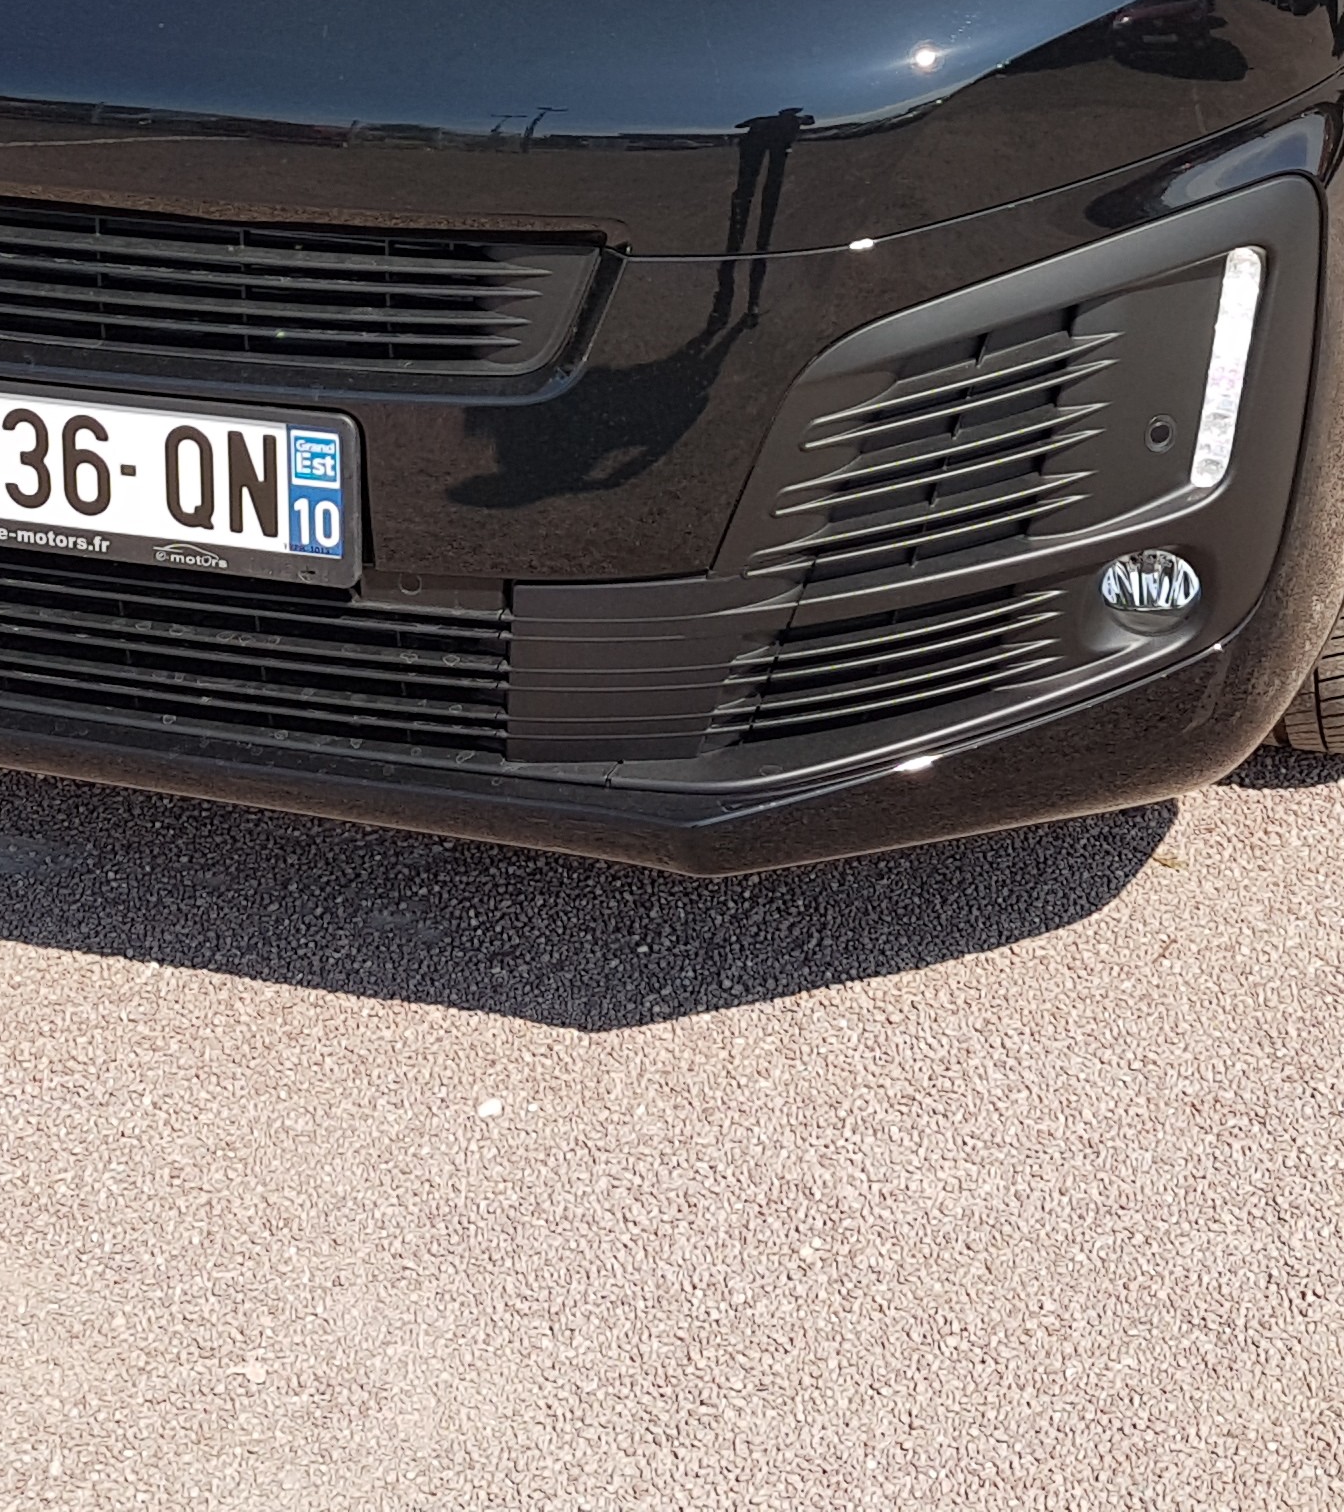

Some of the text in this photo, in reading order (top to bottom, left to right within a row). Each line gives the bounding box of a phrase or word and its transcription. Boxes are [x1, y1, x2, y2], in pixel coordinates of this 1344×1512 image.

[295, 439, 335, 455] Grand
[295, 451, 335, 476] Est
[293, 497, 340, 548] 10
